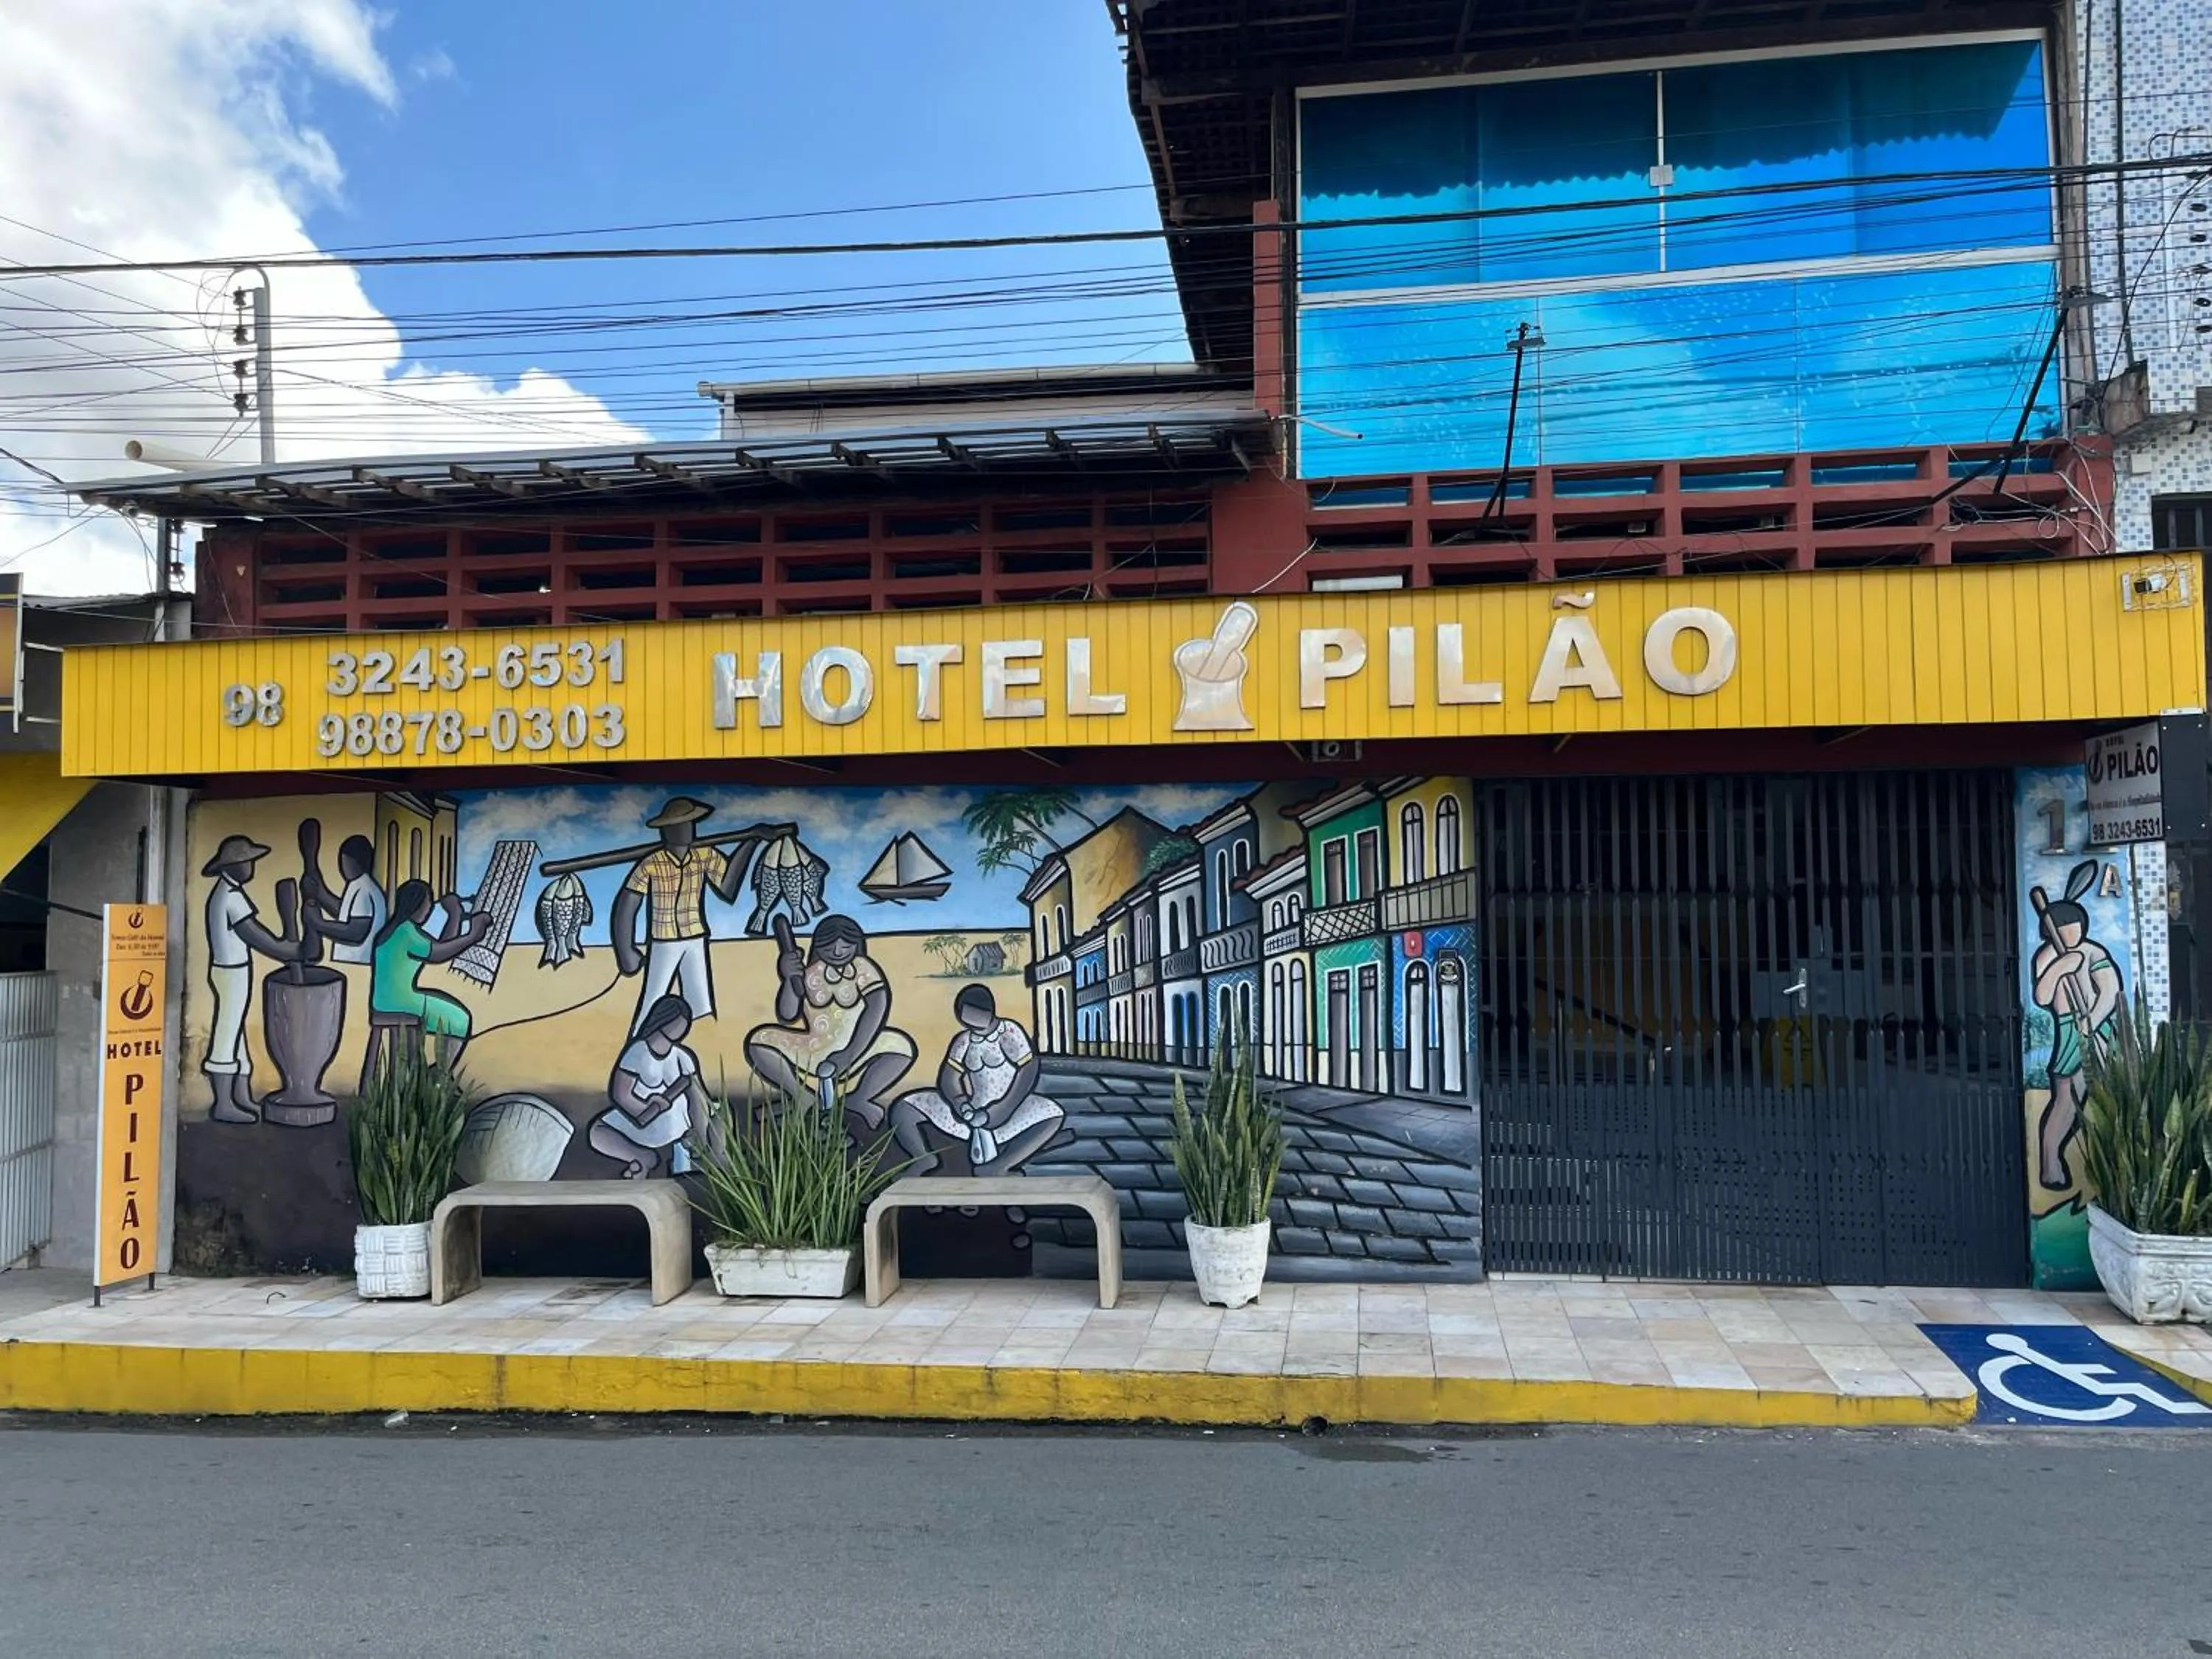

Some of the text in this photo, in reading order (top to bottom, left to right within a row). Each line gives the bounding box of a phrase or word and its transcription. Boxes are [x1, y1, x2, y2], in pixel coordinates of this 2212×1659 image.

[325, 638, 625, 696] 3243-6531
[712, 590, 1736, 729] HOTEL PILÃO
[223, 682, 285, 727] 98
[316, 703, 626, 757] 98878-0303
[2107, 742, 2159, 781] PILÃO
[2107, 816, 2160, 839] 3243-6531
[2099, 862, 2122, 897] A
[107, 1040, 161, 1060] HOTEL
[120, 1073, 144, 1269] PILÃO
